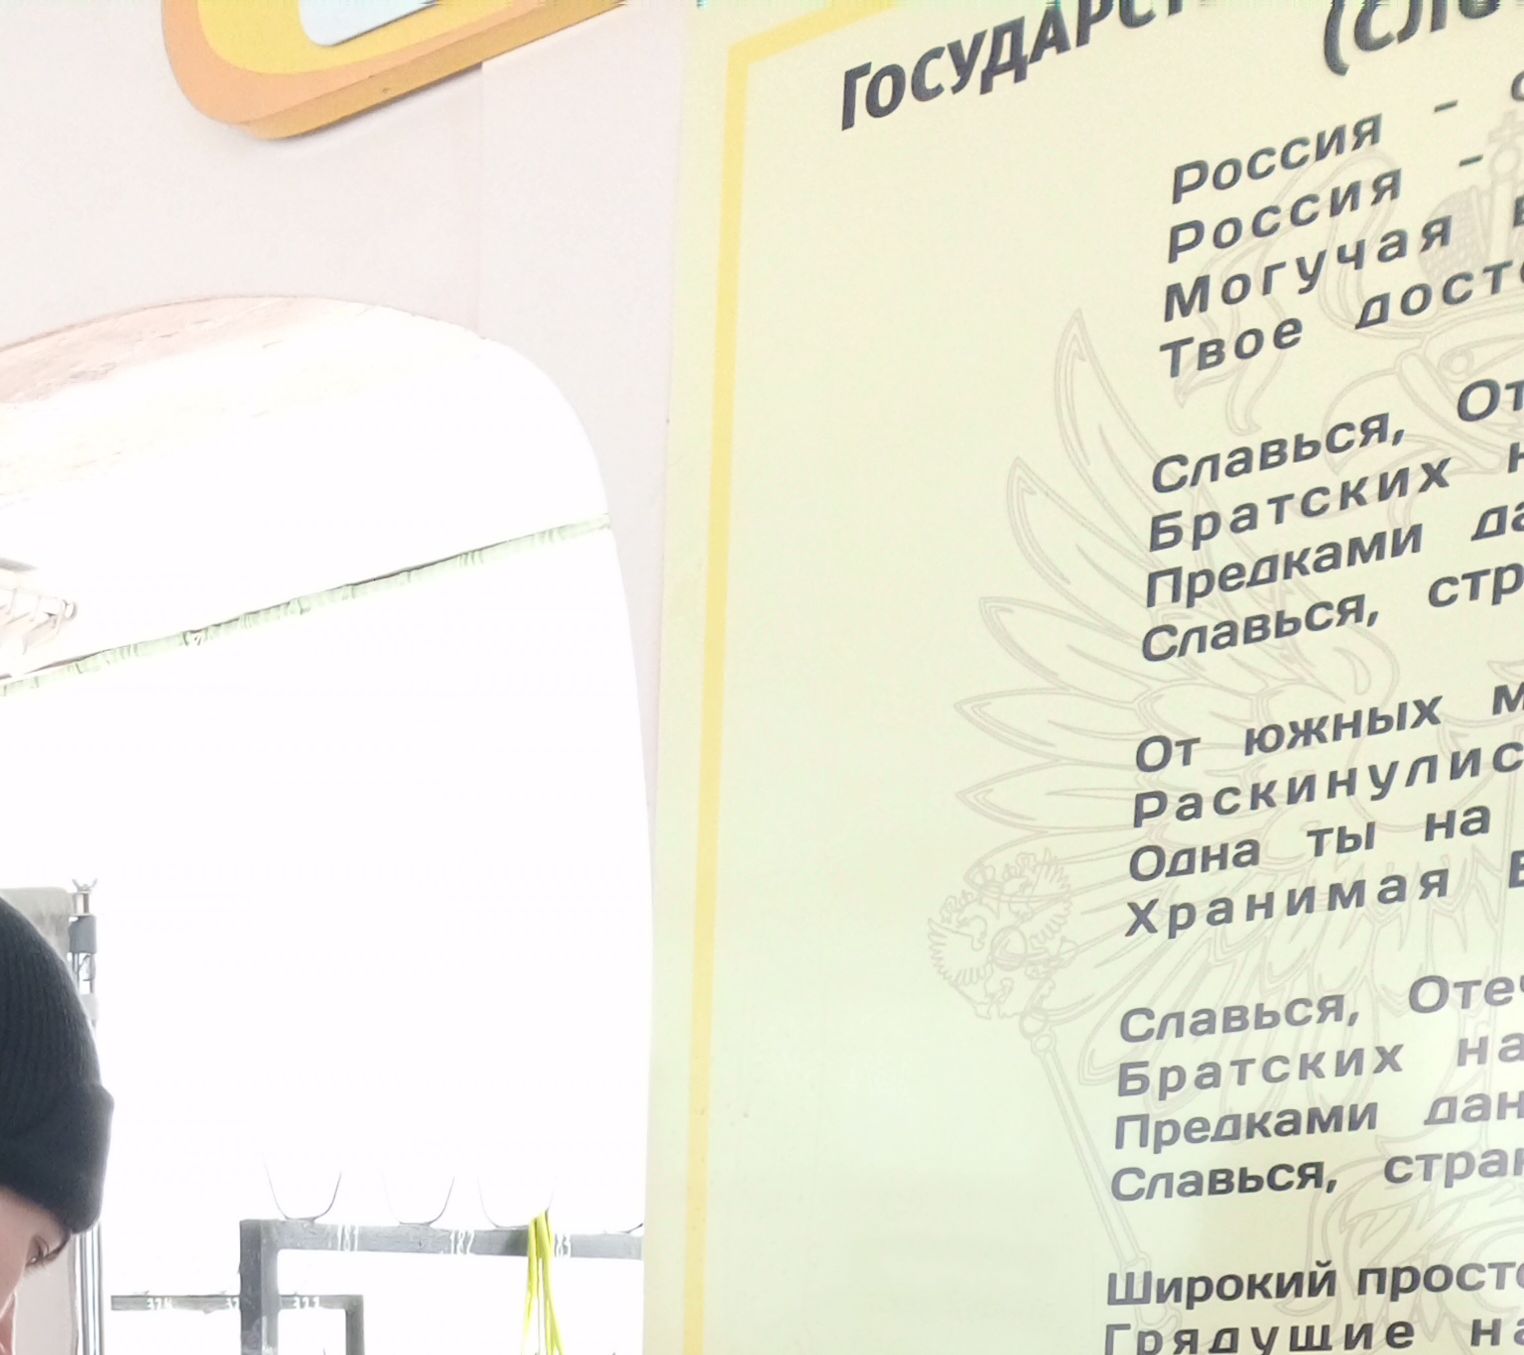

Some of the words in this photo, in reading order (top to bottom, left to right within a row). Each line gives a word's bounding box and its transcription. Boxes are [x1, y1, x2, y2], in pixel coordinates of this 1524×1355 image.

[842, 0, 1182, 131] ГОСУДАРС
[1172, 114, 1382, 204] Россия
[1168, 168, 1401, 264] Россия
[1164, 215, 1452, 322] Могучая
[1159, 318, 1302, 378] Твое
[1354, 260, 1524, 330] дост
[1152, 413, 1404, 493] Славься,
[1149, 457, 1451, 552] Братских
[1147, 523, 1422, 609] Предками
[1142, 594, 1378, 662] Славься,
[1136, 735, 1201, 773] От
[1245, 696, 1443, 756] южных
[1133, 742, 1524, 828] Раскинулис
[1129, 839, 1260, 882] Одна
[1307, 821, 1375, 857] ты
[1425, 806, 1490, 841] на
[1125, 868, 1449, 939] Хранимая
[1120, 994, 1358, 1042] Славься,
[1409, 975, 1524, 1013] Оте
[1118, 1044, 1403, 1101] Братских
[1115, 1102, 1377, 1154] Предками
[1111, 1161, 1337, 1201] Славься,
[1107, 1260, 1336, 1310] Широкий
[1357, 1262, 1524, 1302] прост
